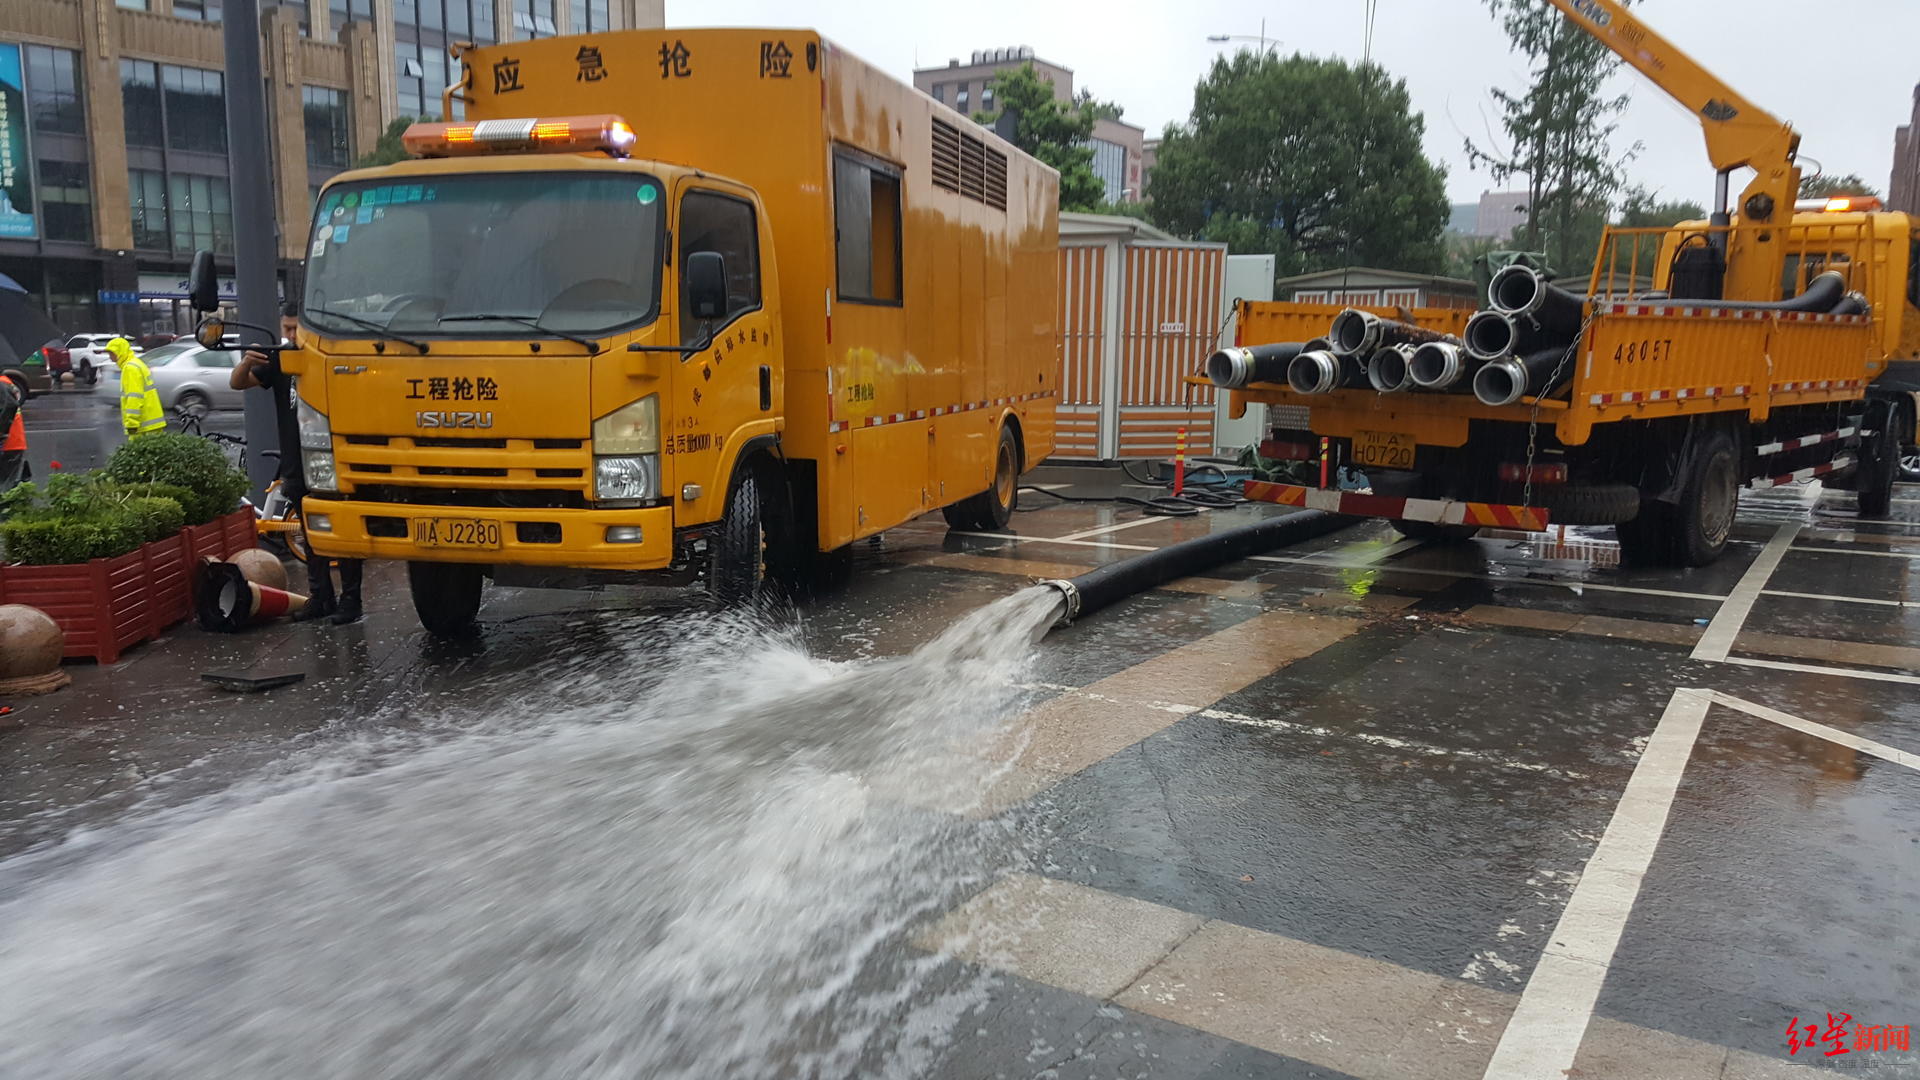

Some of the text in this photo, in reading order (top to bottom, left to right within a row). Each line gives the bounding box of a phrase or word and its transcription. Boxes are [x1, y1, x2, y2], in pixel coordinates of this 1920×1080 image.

[492, 40, 794, 95] 应急抢险
[1614, 338, 1673, 365] 48057
[405, 376, 499, 401] 工程抢险
[847, 382, 875, 403] 工程抢险
[415, 410, 494, 429] ISUZU
[1353, 443, 1412, 466] H0720
